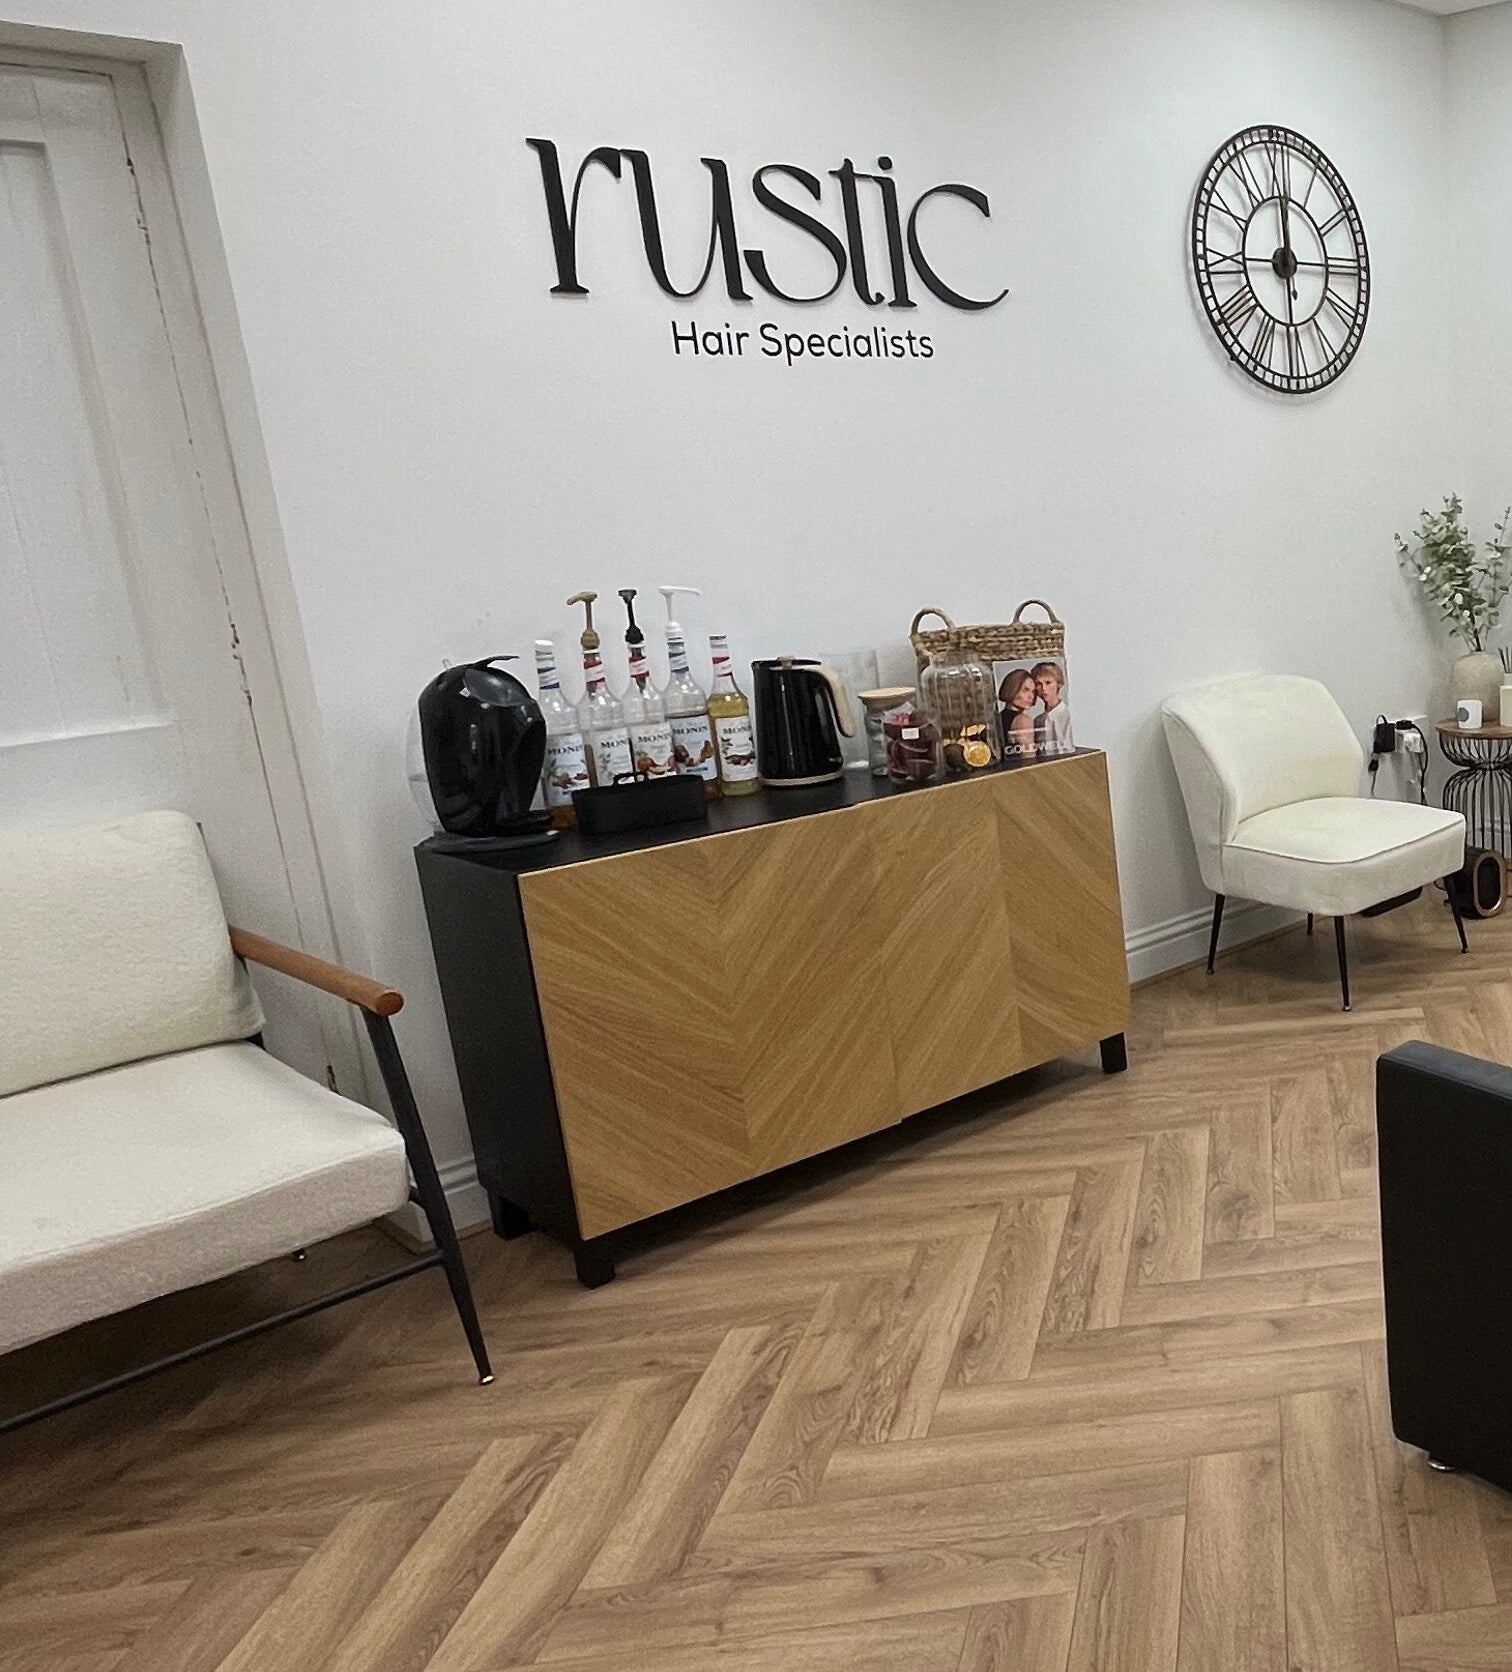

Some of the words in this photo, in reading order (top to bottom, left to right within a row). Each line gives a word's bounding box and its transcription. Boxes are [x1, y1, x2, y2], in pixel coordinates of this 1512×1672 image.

[524, 136, 1010, 311] rustic
[671, 321, 749, 356] Hair
[759, 323, 935, 366] Specialists
[600, 740, 627, 748] MON
